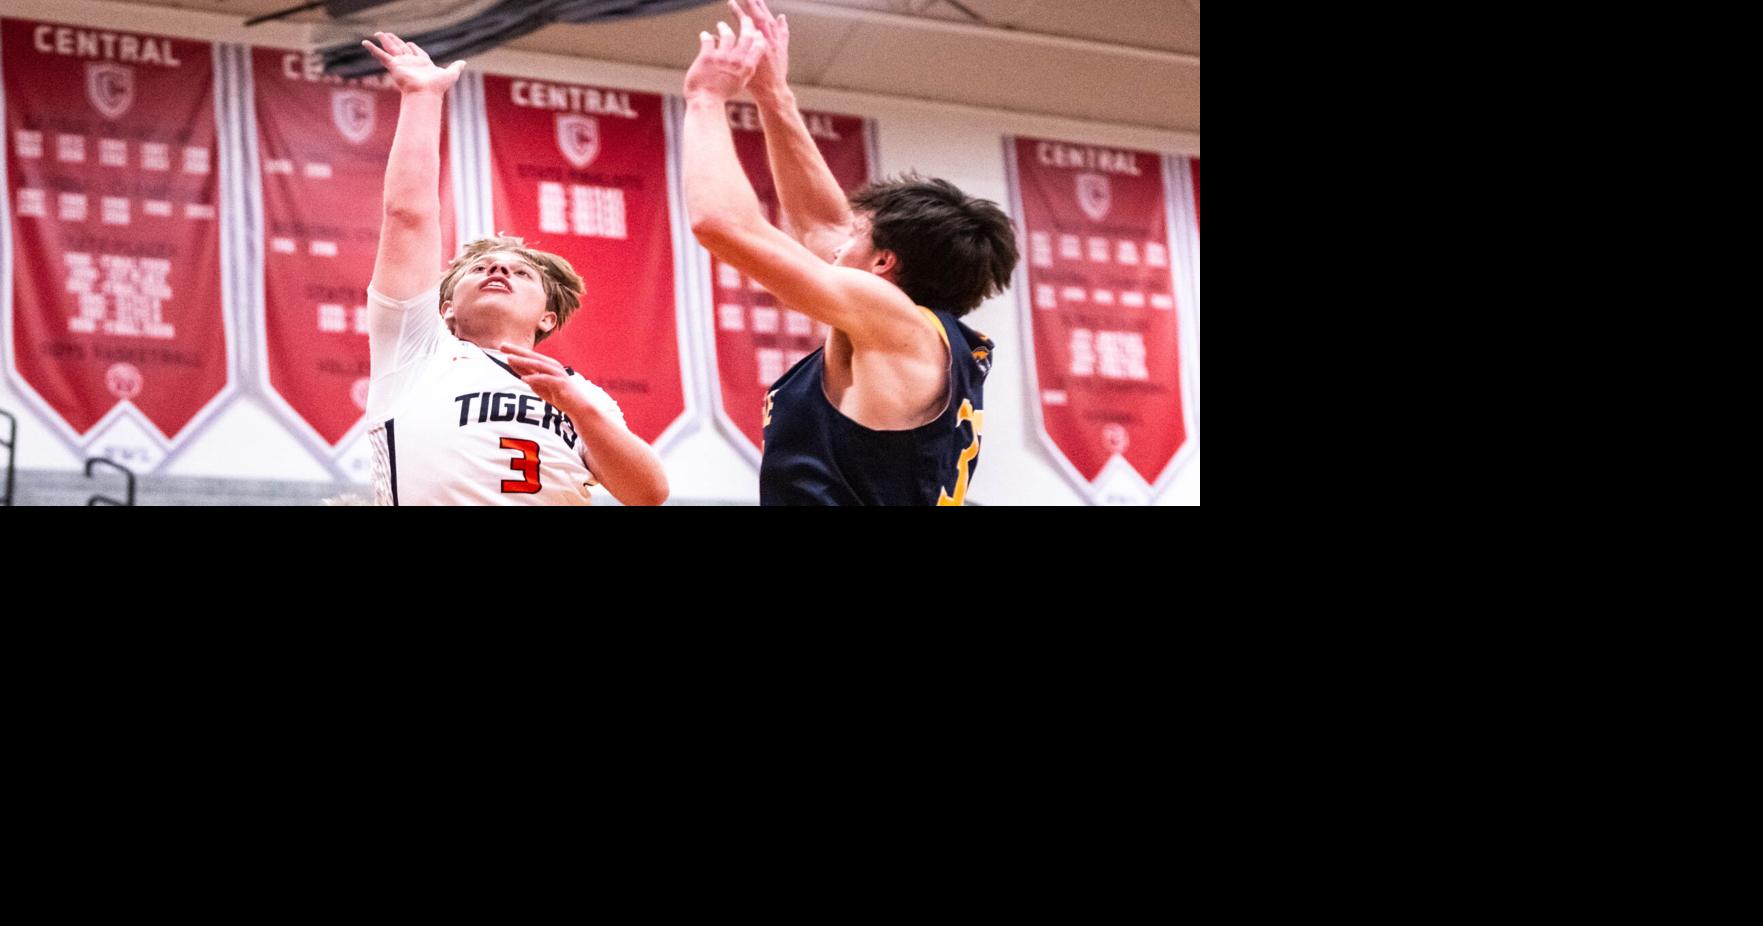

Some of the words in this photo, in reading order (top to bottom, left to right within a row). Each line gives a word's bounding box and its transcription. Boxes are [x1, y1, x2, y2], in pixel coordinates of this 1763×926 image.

[34, 26, 182, 67] CENTRAL
[511, 78, 639, 119] CENTRAL
[1037, 142, 1142, 177] CENTRAL
[454, 391, 578, 450] TIGERS
[499, 436, 542, 494] 3
